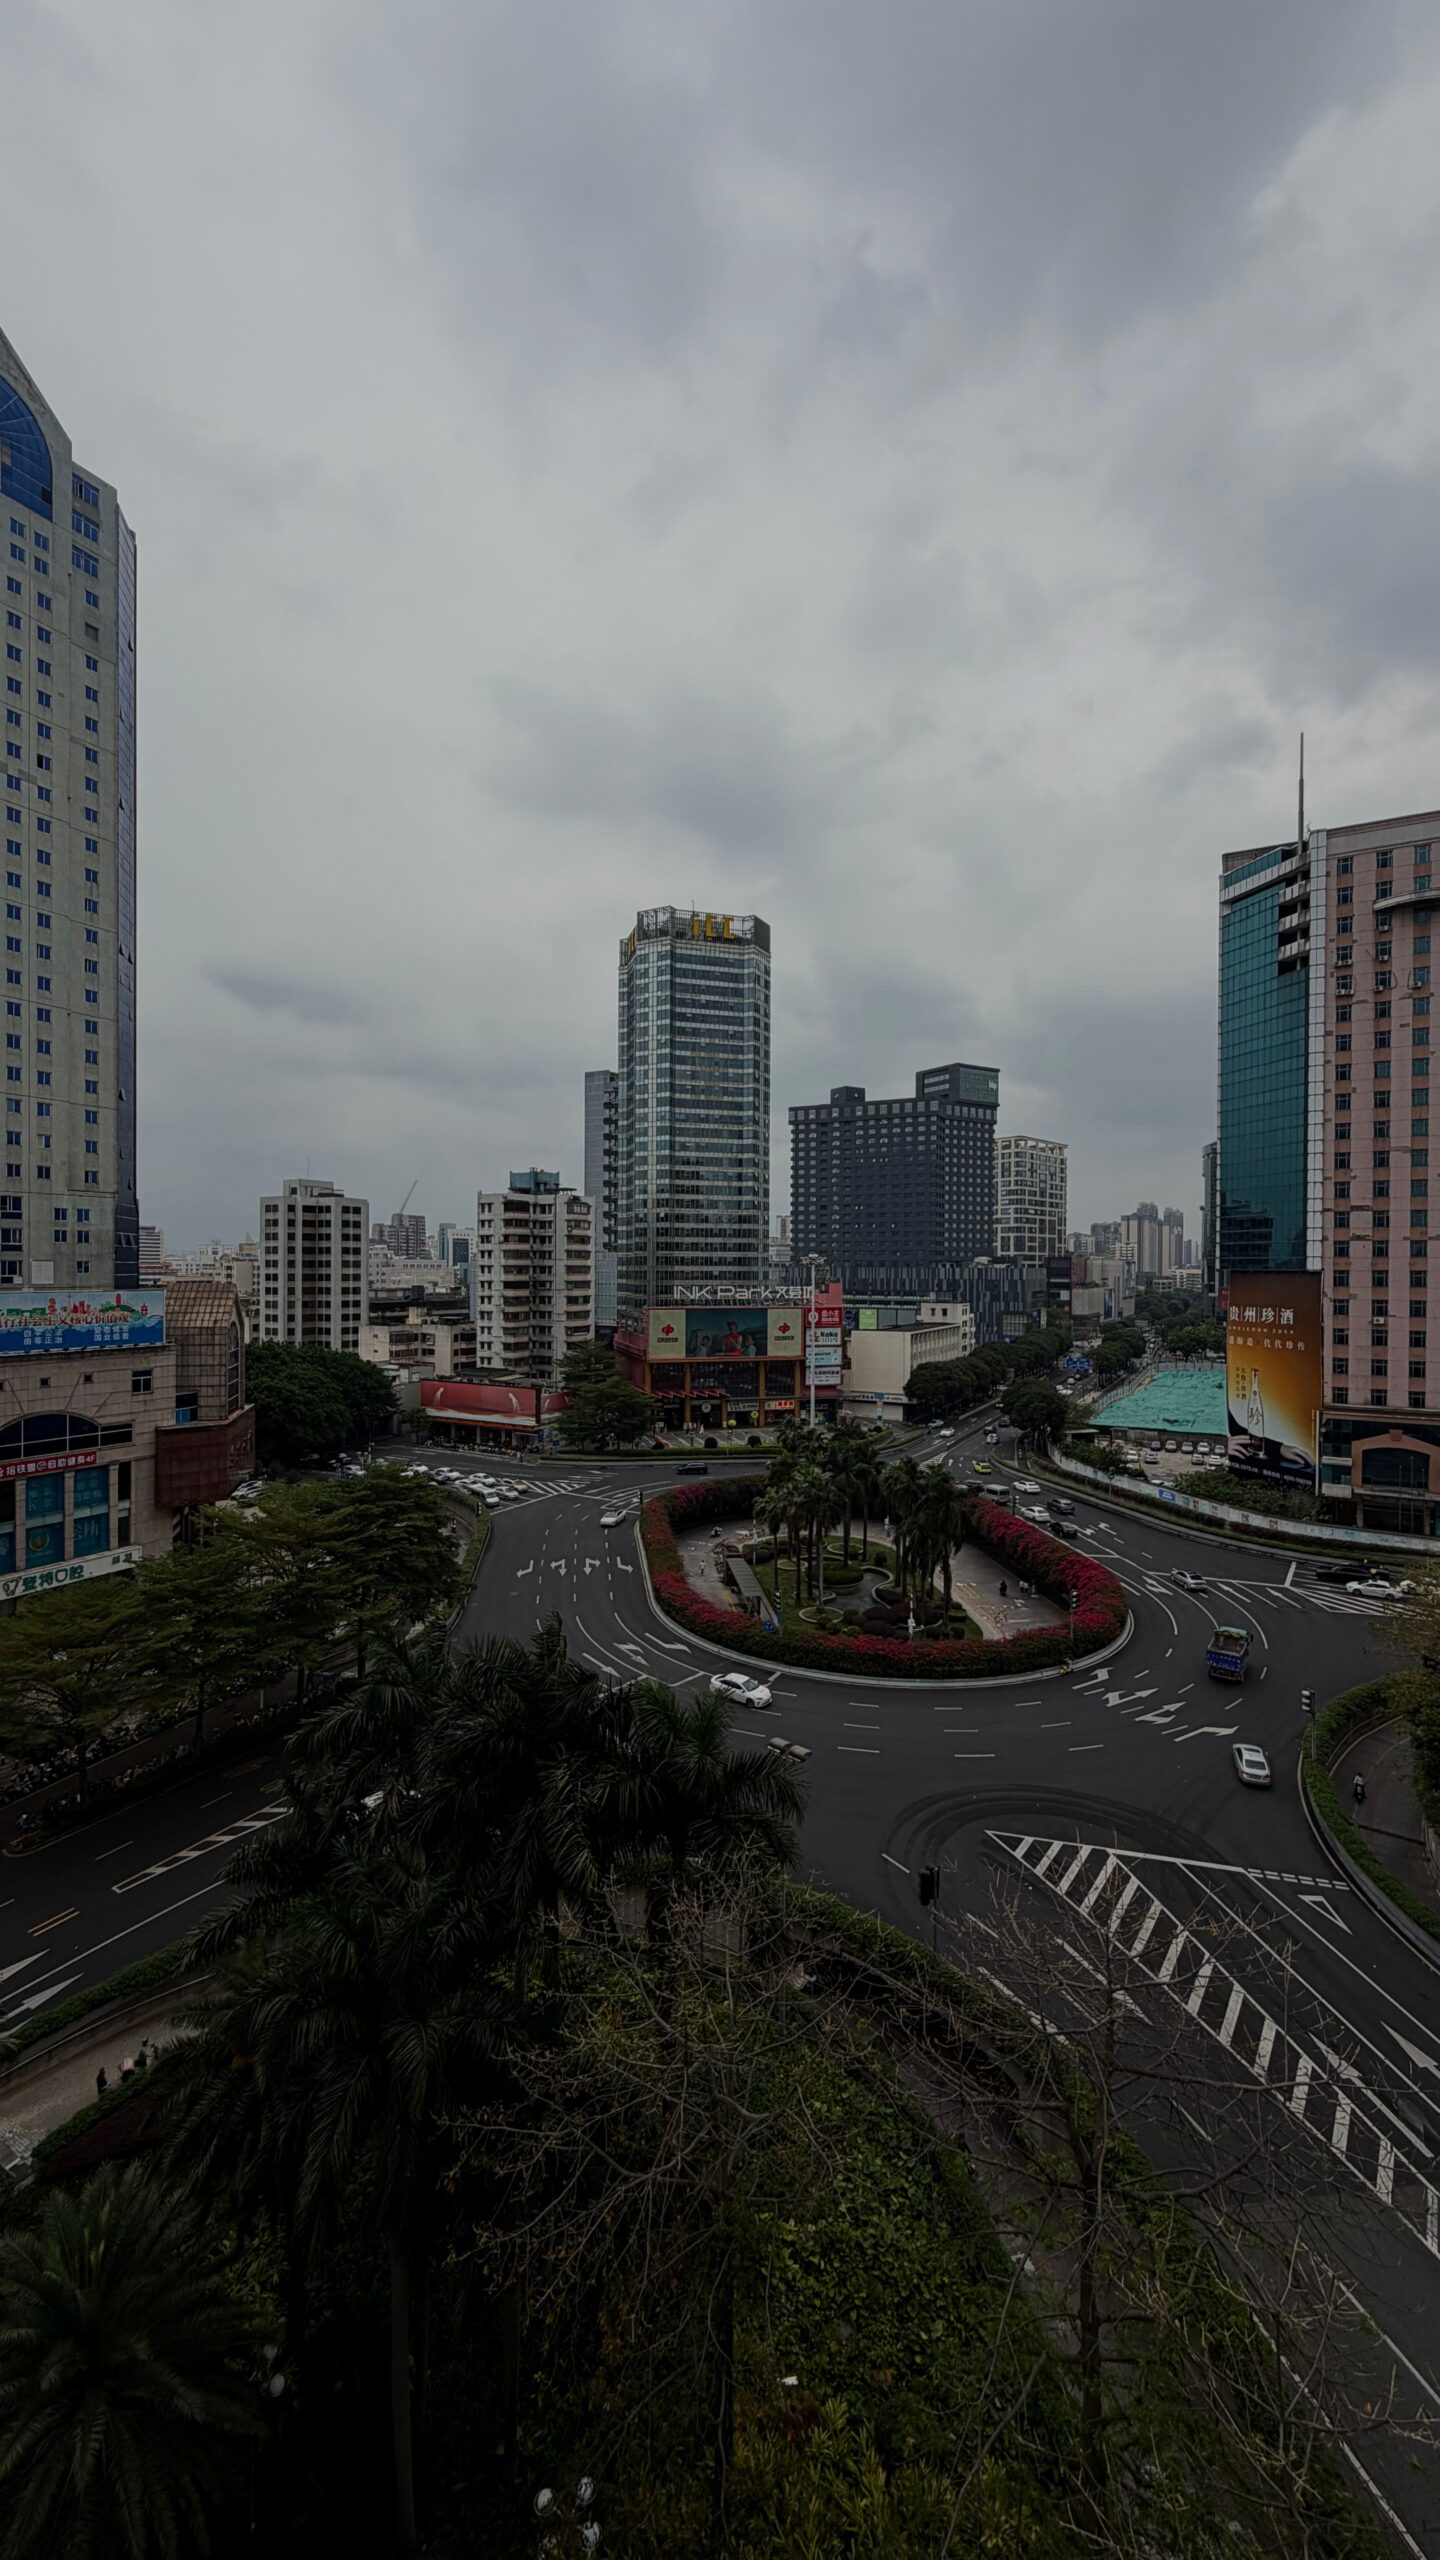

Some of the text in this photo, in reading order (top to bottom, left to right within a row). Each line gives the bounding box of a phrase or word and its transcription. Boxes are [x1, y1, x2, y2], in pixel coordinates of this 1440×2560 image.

[673, 1285, 773, 1299] INK Park
[1229, 1305, 1294, 1325] 贵州珍酒
